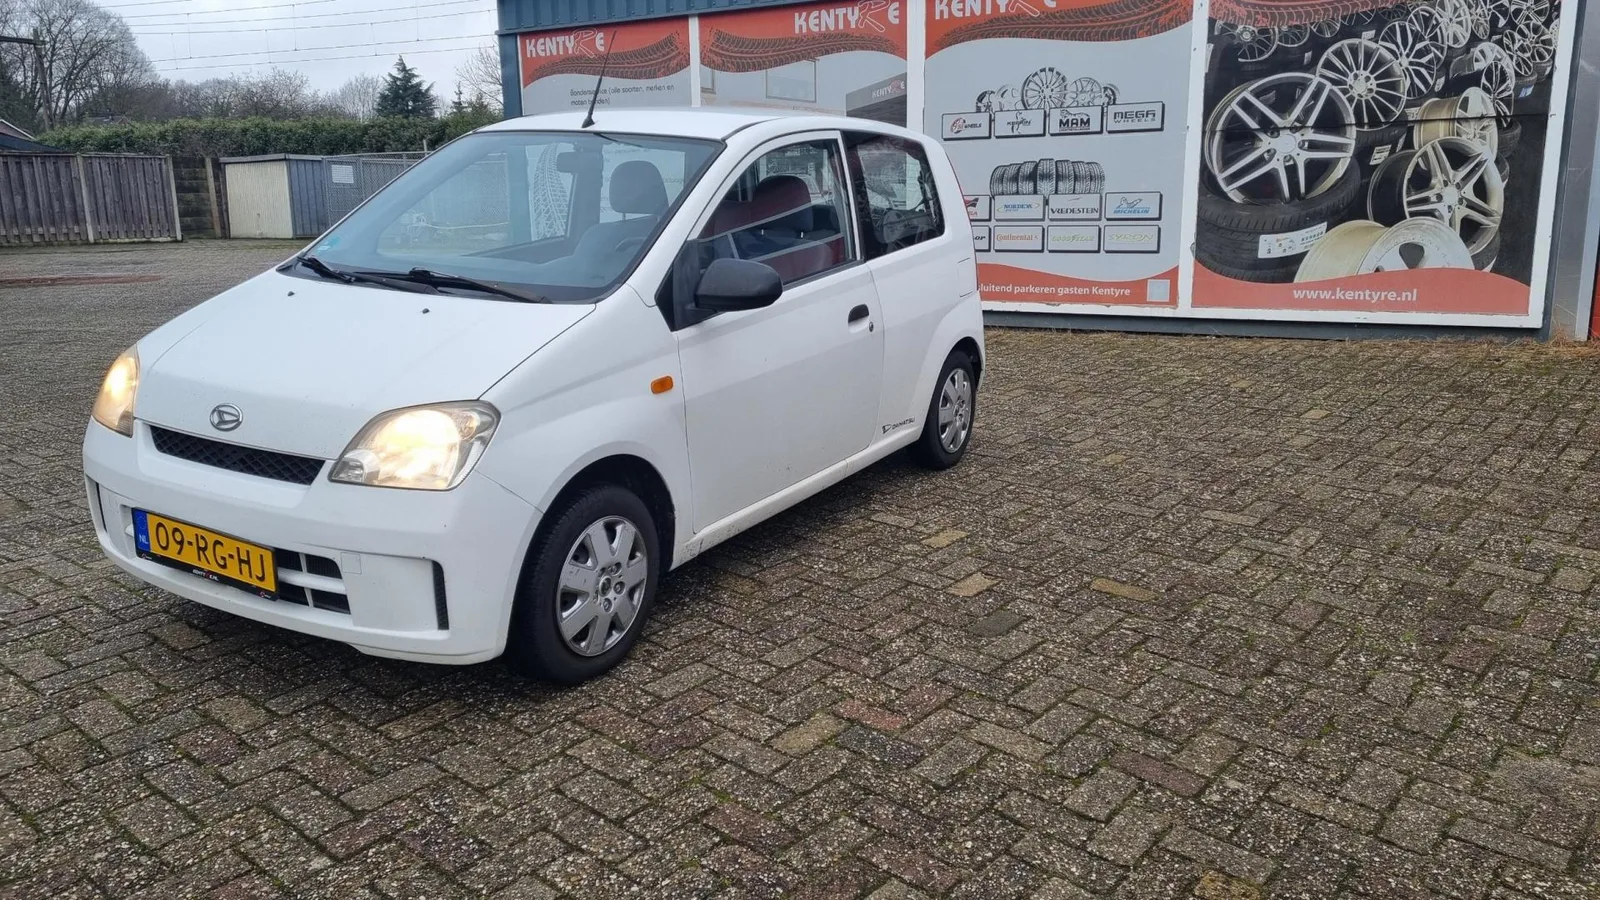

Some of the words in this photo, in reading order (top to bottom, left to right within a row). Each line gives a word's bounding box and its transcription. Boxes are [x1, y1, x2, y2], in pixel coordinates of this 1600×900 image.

[794, 0, 900, 33] KENTYRE
[526, 27, 605, 58] KENTYRE
[1114, 110, 1156, 120] MEGA
[1059, 118, 1090, 128] MAM
[996, 233, 1033, 241] Continental
[1014, 284, 1055, 294] parkeren
[1058, 287, 1089, 296] gasten
[1092, 287, 1131, 296] Kentyre
[1293, 287, 1417, 303] www.kentyre.nl
[155, 521, 266, 582] 09-RG-HJ
